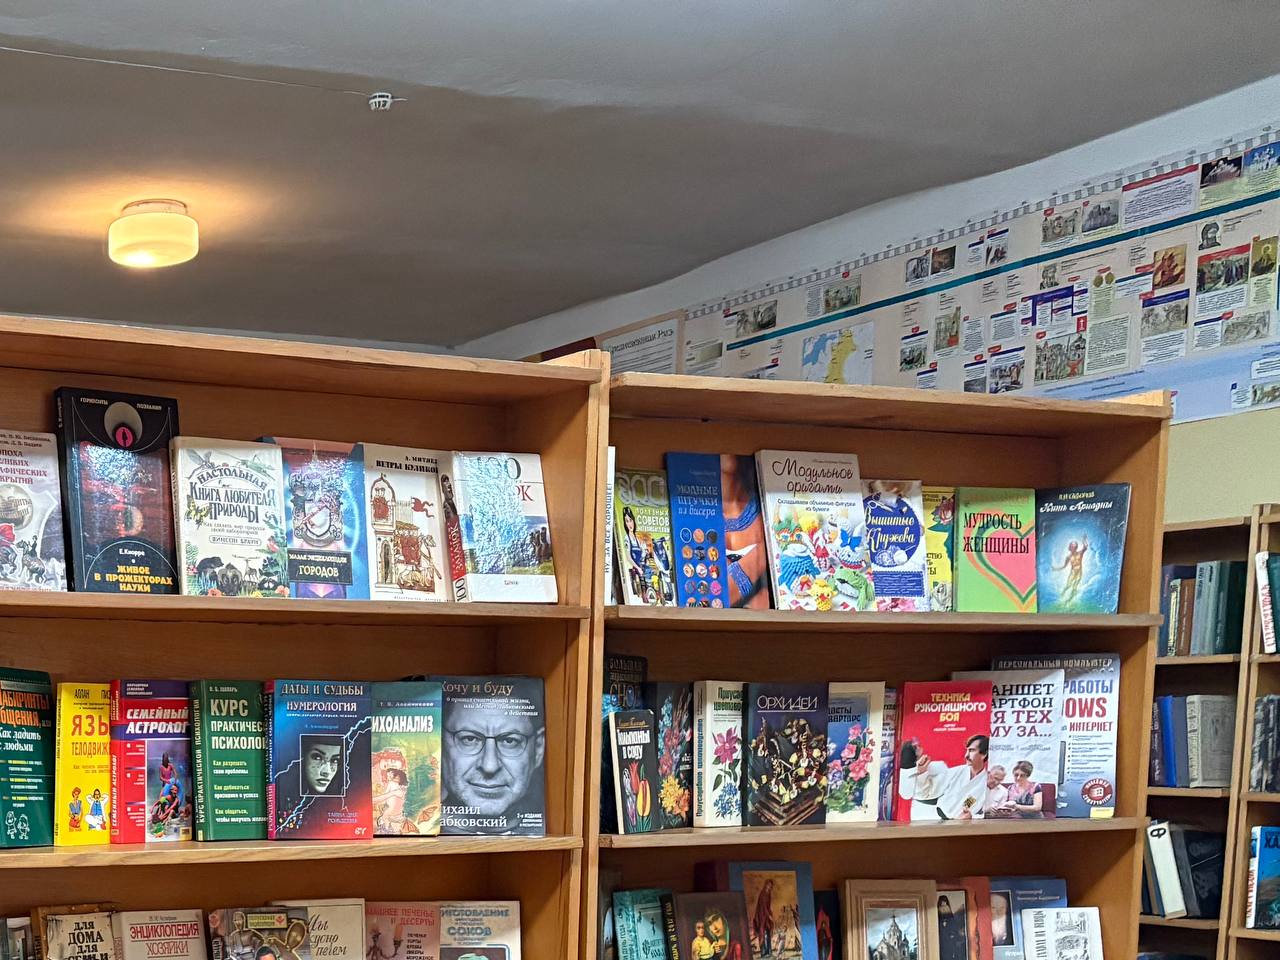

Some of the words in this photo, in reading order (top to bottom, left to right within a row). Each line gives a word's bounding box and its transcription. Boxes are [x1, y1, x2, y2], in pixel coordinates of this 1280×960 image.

[772, 458, 853, 485] Модульное
[197, 467, 268, 491] НАСТОЛЬНАЯ
[189, 481, 222, 503] КНИГА
[223, 487, 276, 507] ЛЮБИТЕЛЯ
[786, 482, 843, 497] оригами
[834, 500, 856, 508] фигурки
[1069, 500, 1113, 513] Ариадны
[208, 502, 259, 523] ПРИРОДЫ
[688, 504, 716, 518] бисера
[637, 514, 669, 526] СОВЕТОВ
[964, 512, 1022, 530] МУДРОСТЬ
[963, 537, 1029, 555] ЖЕНЩИНЫ
[117, 565, 150, 574] ЖИВОЕ
[298, 565, 340, 578] ГОРОДОВ
[94, 573, 100, 581] В
[106, 574, 173, 586] ПРОЖЕКТОРАХ
[120, 583, 151, 593] НАУКИ
[1064, 659, 1112, 668] КОМПЬЮТЕР
[281, 684, 309, 695] ДАТЫ
[313, 684, 320, 694] И
[324, 684, 364, 695] СУДЬБЫ
[472, 684, 480, 693] и
[484, 682, 514, 695] буду
[1063, 679, 1113, 694] РАБОТЫ
[74, 688, 90, 699] АЛЛАН
[930, 693, 971, 702] ТЕХНИКА
[210, 700, 249, 717] КУРС
[286, 700, 357, 712] НУМЕРОЛОГИЯ
[757, 696, 818, 710] ОРХИДЕИ
[914, 702, 987, 713] РУКОПАШНОГО
[126, 706, 189, 720] СЕМЕЙНЫЙ
[939, 713, 960, 722] БОЯ
[1011, 710, 1052, 723] ТЕХ
[126, 721, 189, 734] АСТРОЛОГ
[1016, 726, 1052, 738] ЗА...
[1069, 721, 1113, 732] ИНТЕРНЕТ
[13, 729, 41, 741] ладить
[3, 738, 33, 752] людьми
[74, 921, 95, 931] ДЛЯ
[400, 918, 435, 926] ДЕСЕРТЫ
[129, 921, 200, 940] ЭНЦИКЛОПЕДИЯ
[448, 926, 492, 937] СОКОВ
[68, 930, 105, 945] ДОМА
[77, 943, 98, 954] ДЛЯ
[146, 939, 189, 955] ХОЗЯЙКИ
